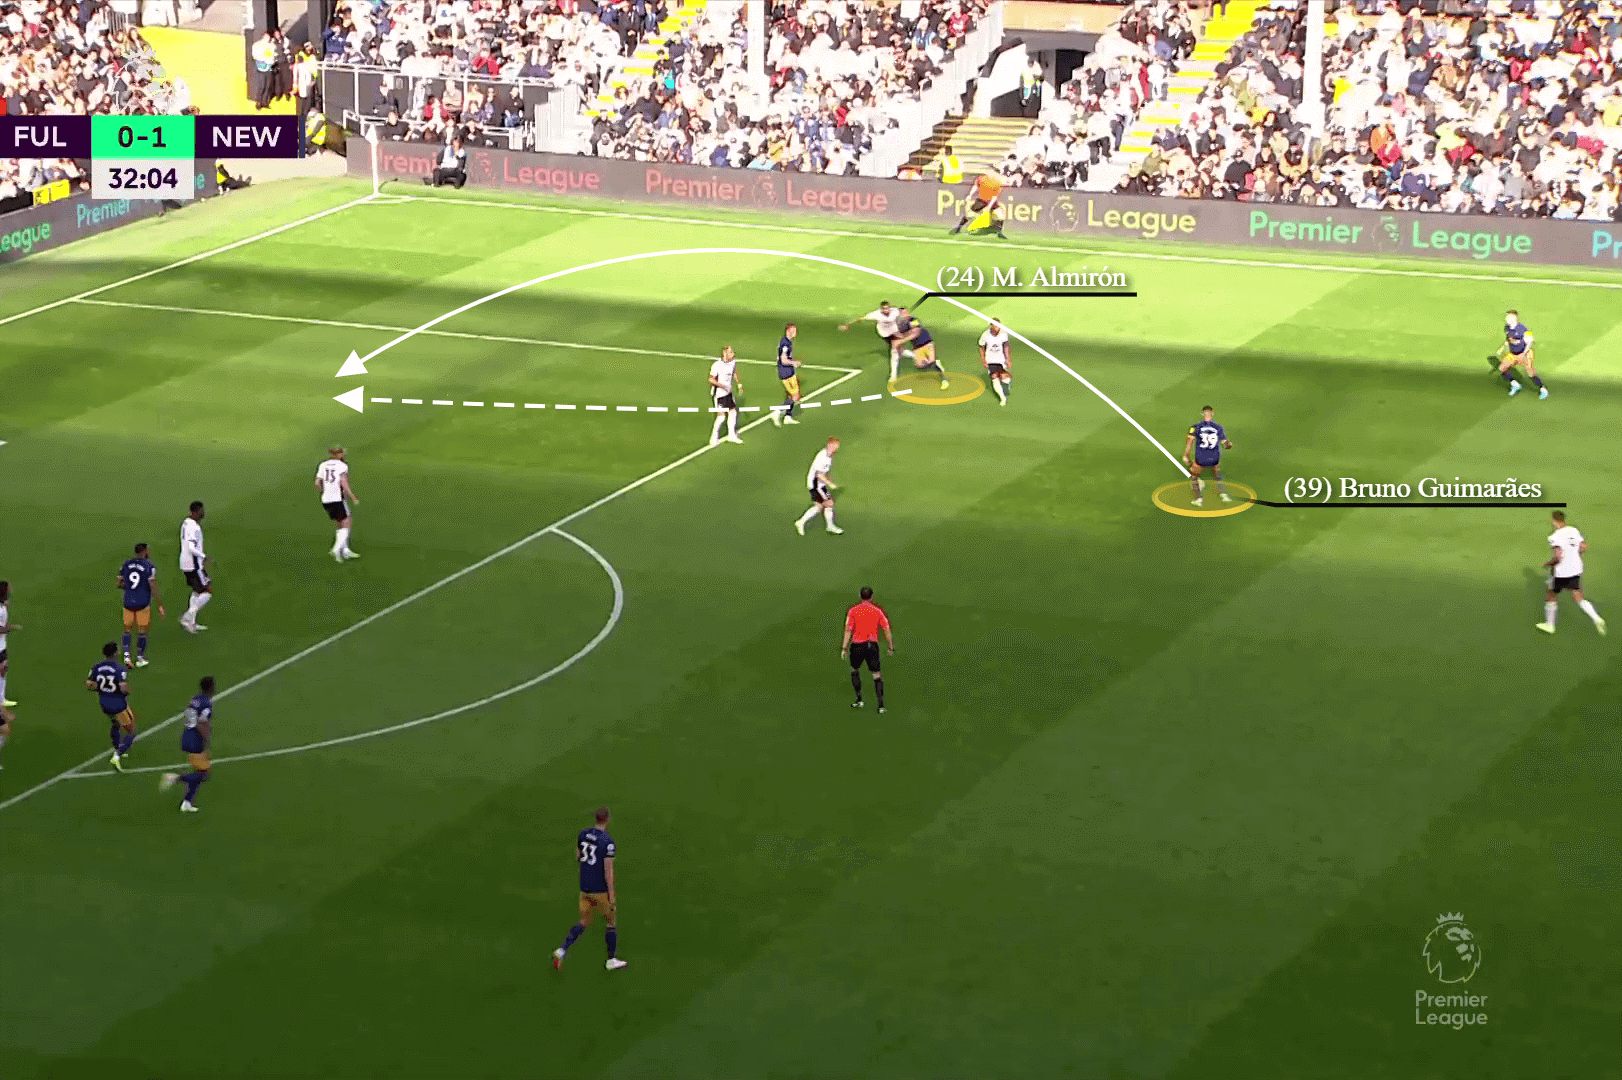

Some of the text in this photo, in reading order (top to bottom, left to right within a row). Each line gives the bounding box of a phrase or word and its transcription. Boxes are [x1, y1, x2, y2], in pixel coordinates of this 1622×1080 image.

[504, 157, 600, 193] League
[645, 168, 888, 213] Premier League
[1087, 200, 1197, 238] League
[0, 223, 51, 253] eague
[1250, 211, 1533, 258] Premier League
[1200, 433, 1218, 449] 39
[129, 572, 140, 589] 9
[97, 675, 116, 692] 23
[580, 841, 597, 865] 33
